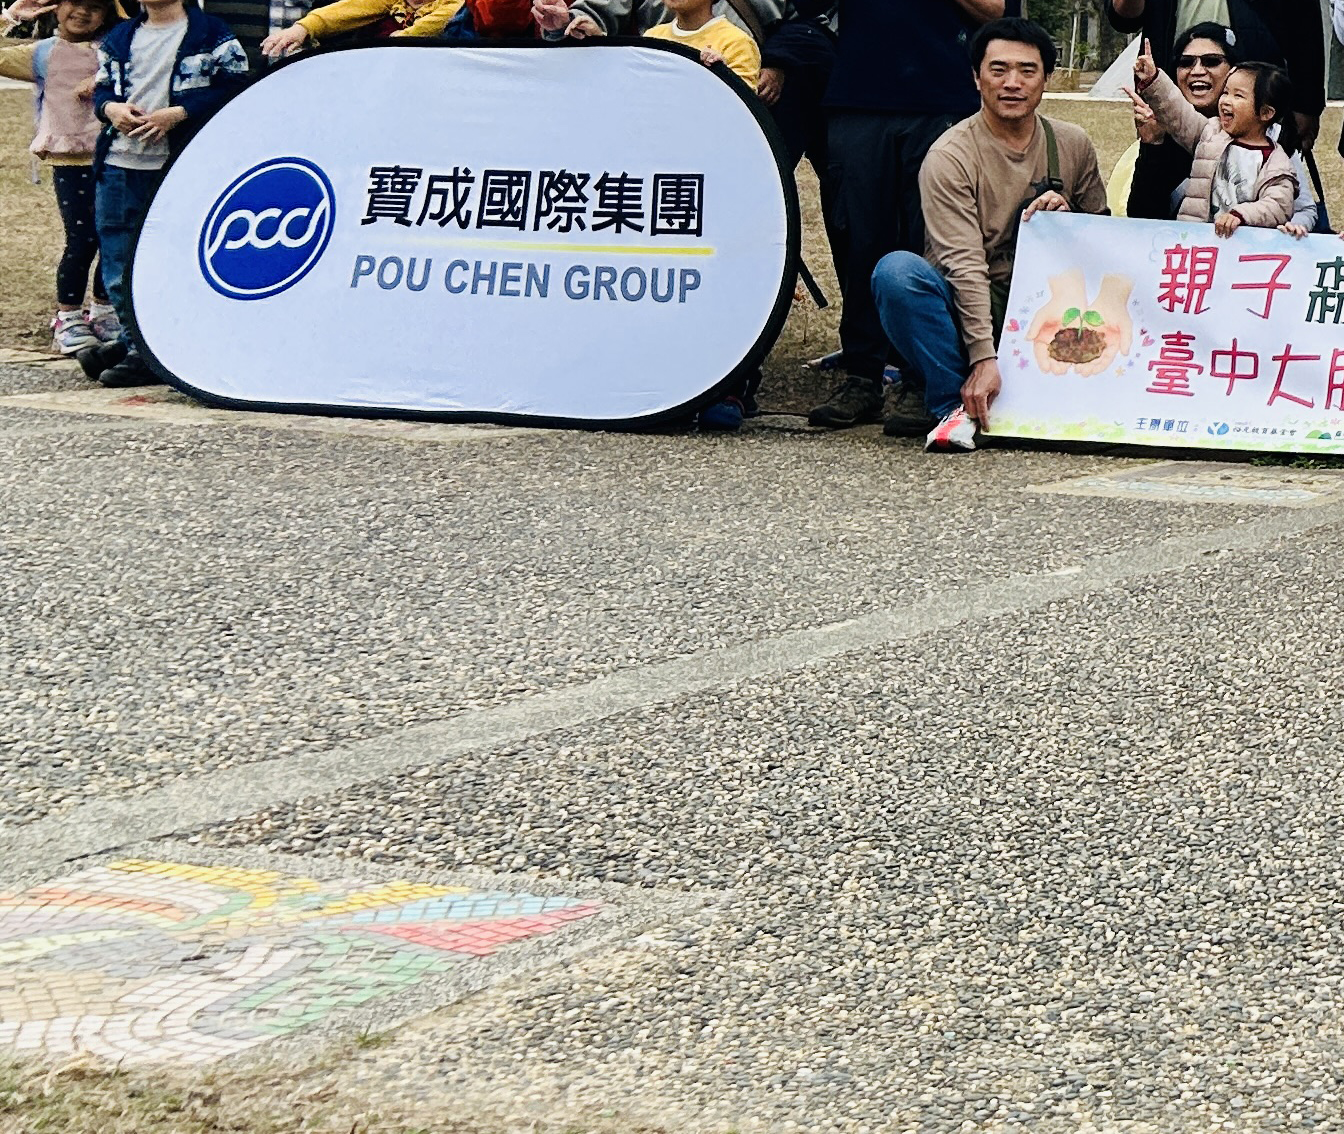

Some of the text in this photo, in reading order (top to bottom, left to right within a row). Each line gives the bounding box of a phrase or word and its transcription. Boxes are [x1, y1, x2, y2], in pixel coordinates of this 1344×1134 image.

[361, 165, 705, 238] 寶成國際集團
[350, 255, 701, 304] POU CHEN GROUP
